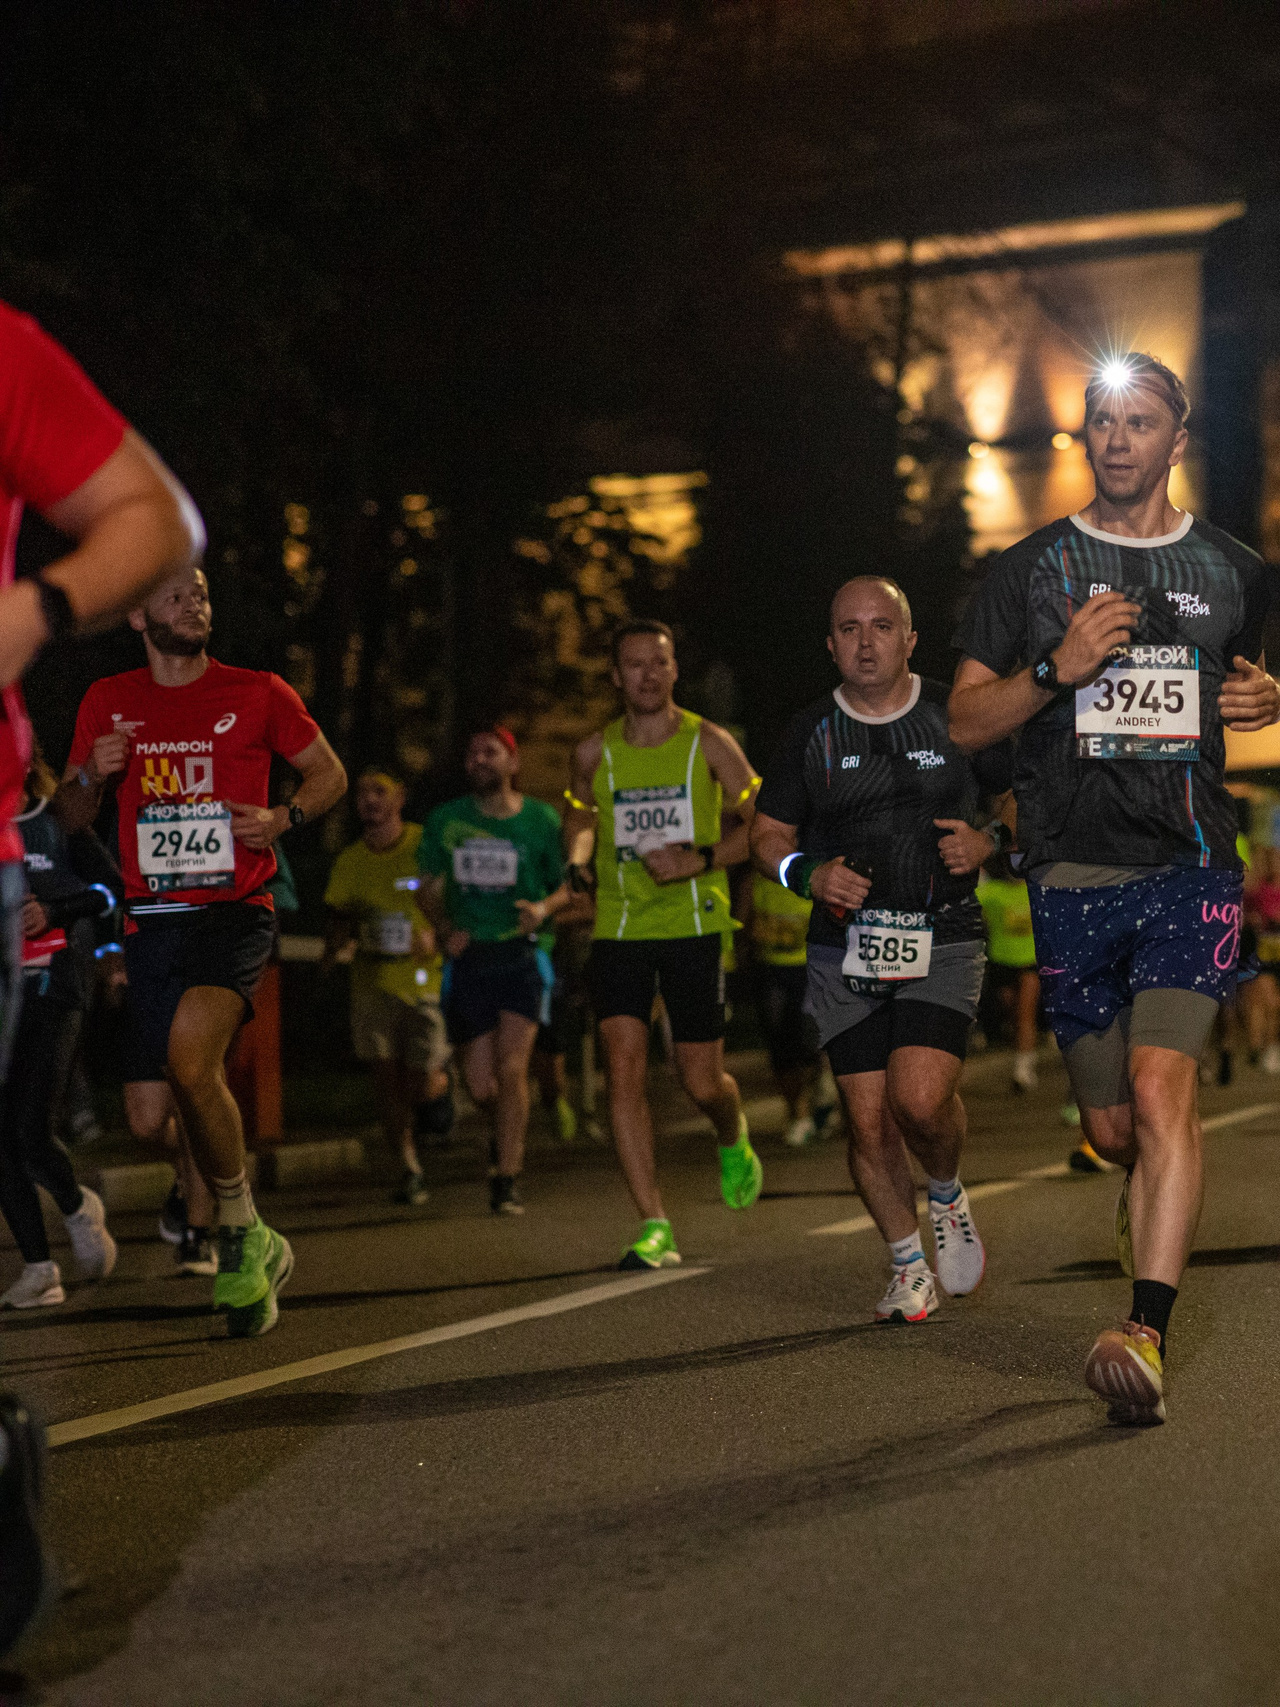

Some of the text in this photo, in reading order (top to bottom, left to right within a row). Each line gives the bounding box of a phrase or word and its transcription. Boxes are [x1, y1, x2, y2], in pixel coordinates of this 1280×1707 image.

[1093, 678, 1184, 714] 3945
[1115, 717, 1161, 727] ANDREY
[136, 740, 214, 755] МАРАФОН
[841, 755, 860, 769] GRi
[624, 806, 681, 832] 3004
[151, 827, 221, 858] 2946
[166, 858, 206, 868] ГЕОРГИЙ
